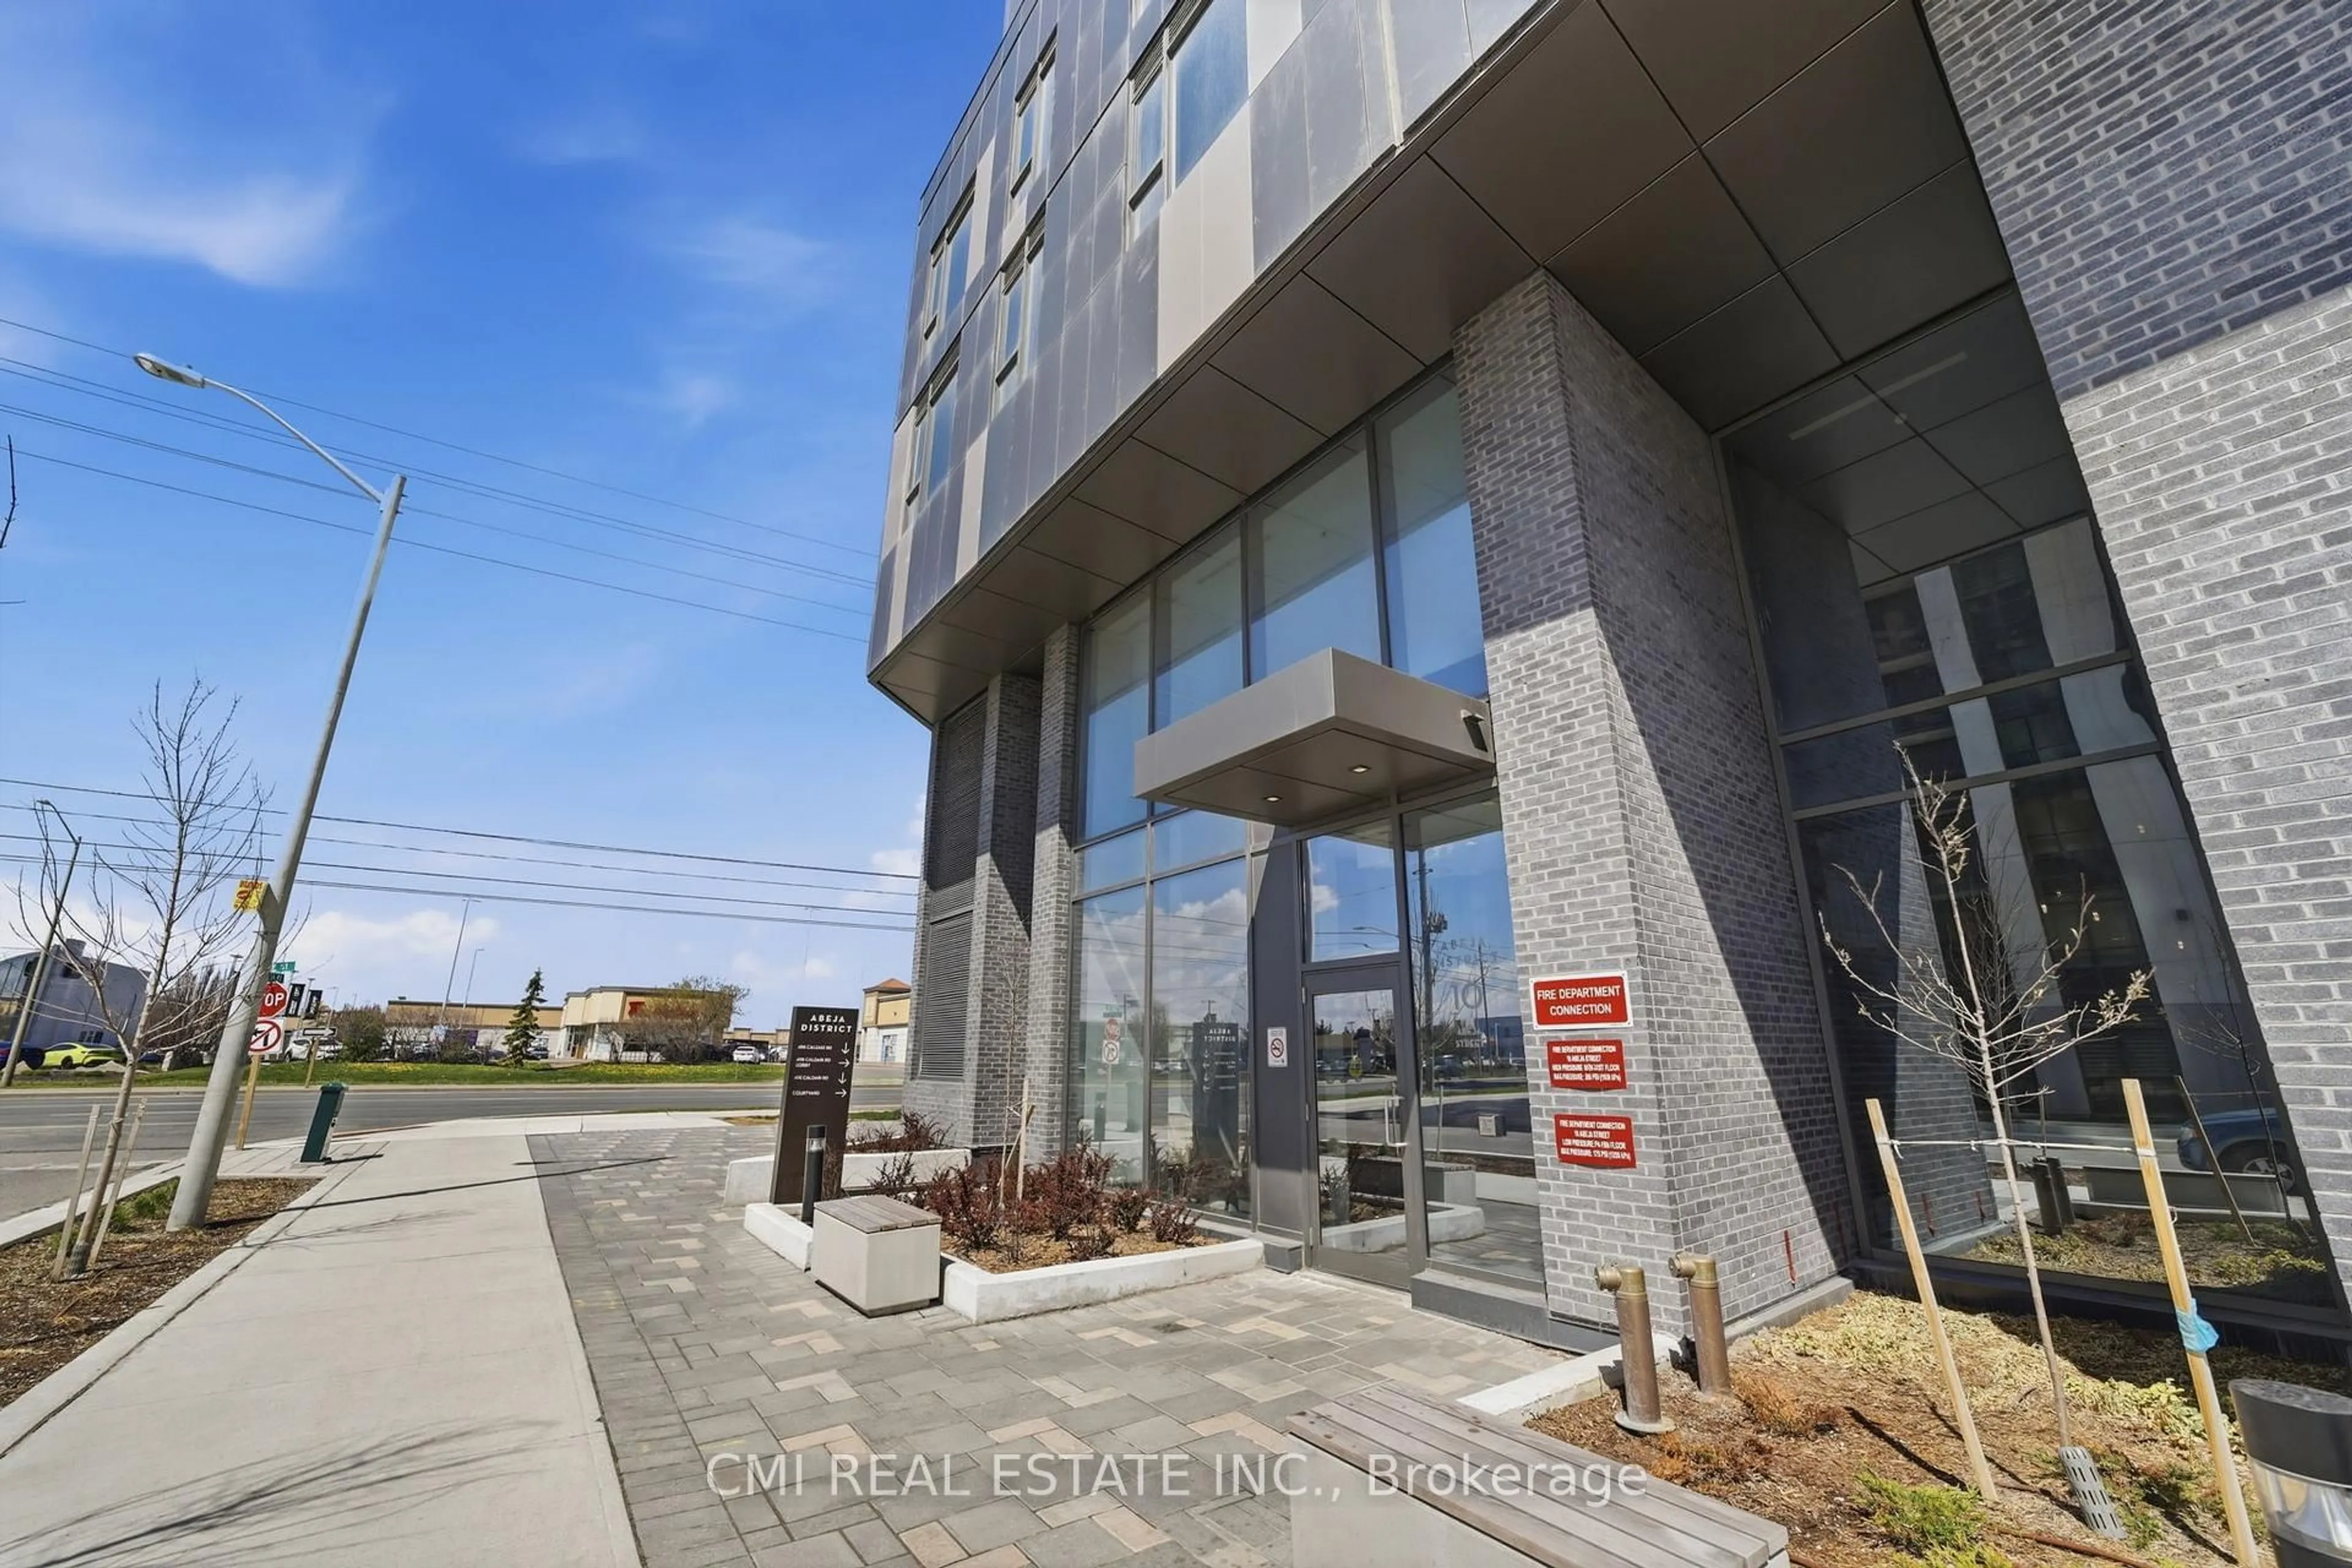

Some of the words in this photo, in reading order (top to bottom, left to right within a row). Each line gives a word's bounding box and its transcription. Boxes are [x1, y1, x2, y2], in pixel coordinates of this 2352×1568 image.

[1537, 989, 1556, 1000] FIRE
[1559, 986, 1621, 1000] DEPARTMENT
[263, 993, 285, 1007] OP
[1550, 1003, 1612, 1016] CONNECTION
[810, 1014, 845, 1023] ABEJA
[801, 1023, 852, 1033] DISTRICT
